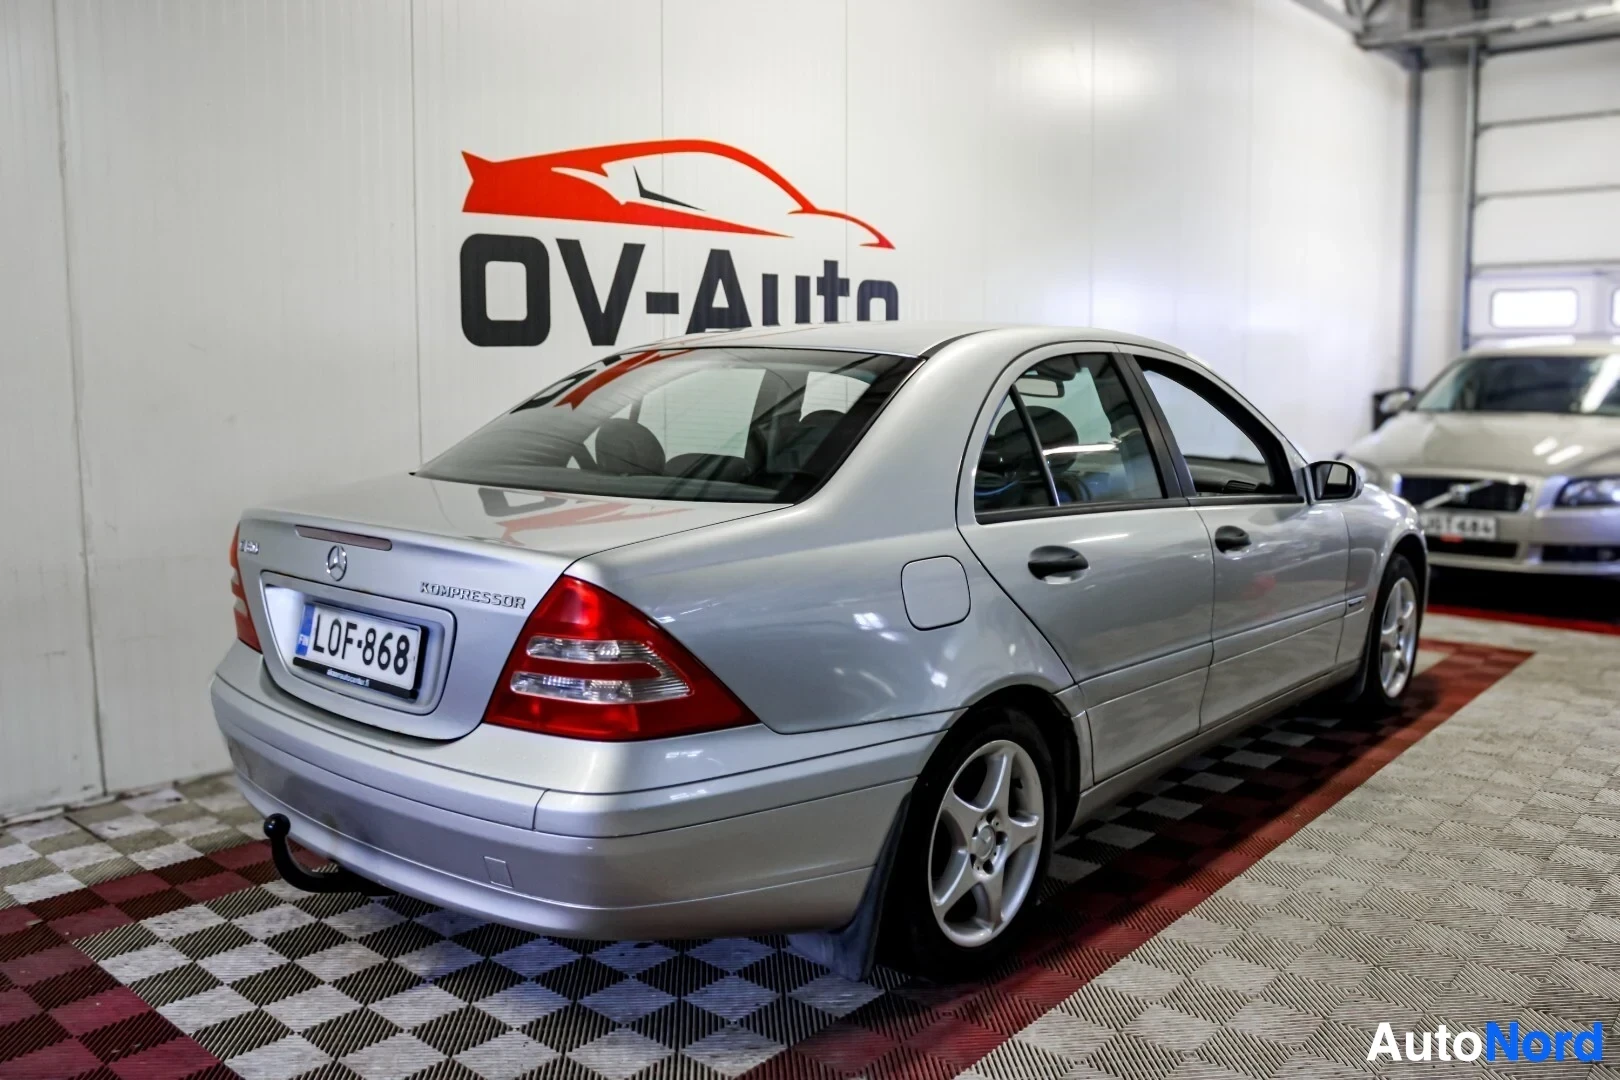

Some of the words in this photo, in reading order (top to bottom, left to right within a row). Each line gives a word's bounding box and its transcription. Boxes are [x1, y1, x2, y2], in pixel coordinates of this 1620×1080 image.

[460, 233, 899, 347] OV-Auto
[420, 581, 526, 609] KOMPRESSOR
[313, 614, 410, 675] LOF-868
